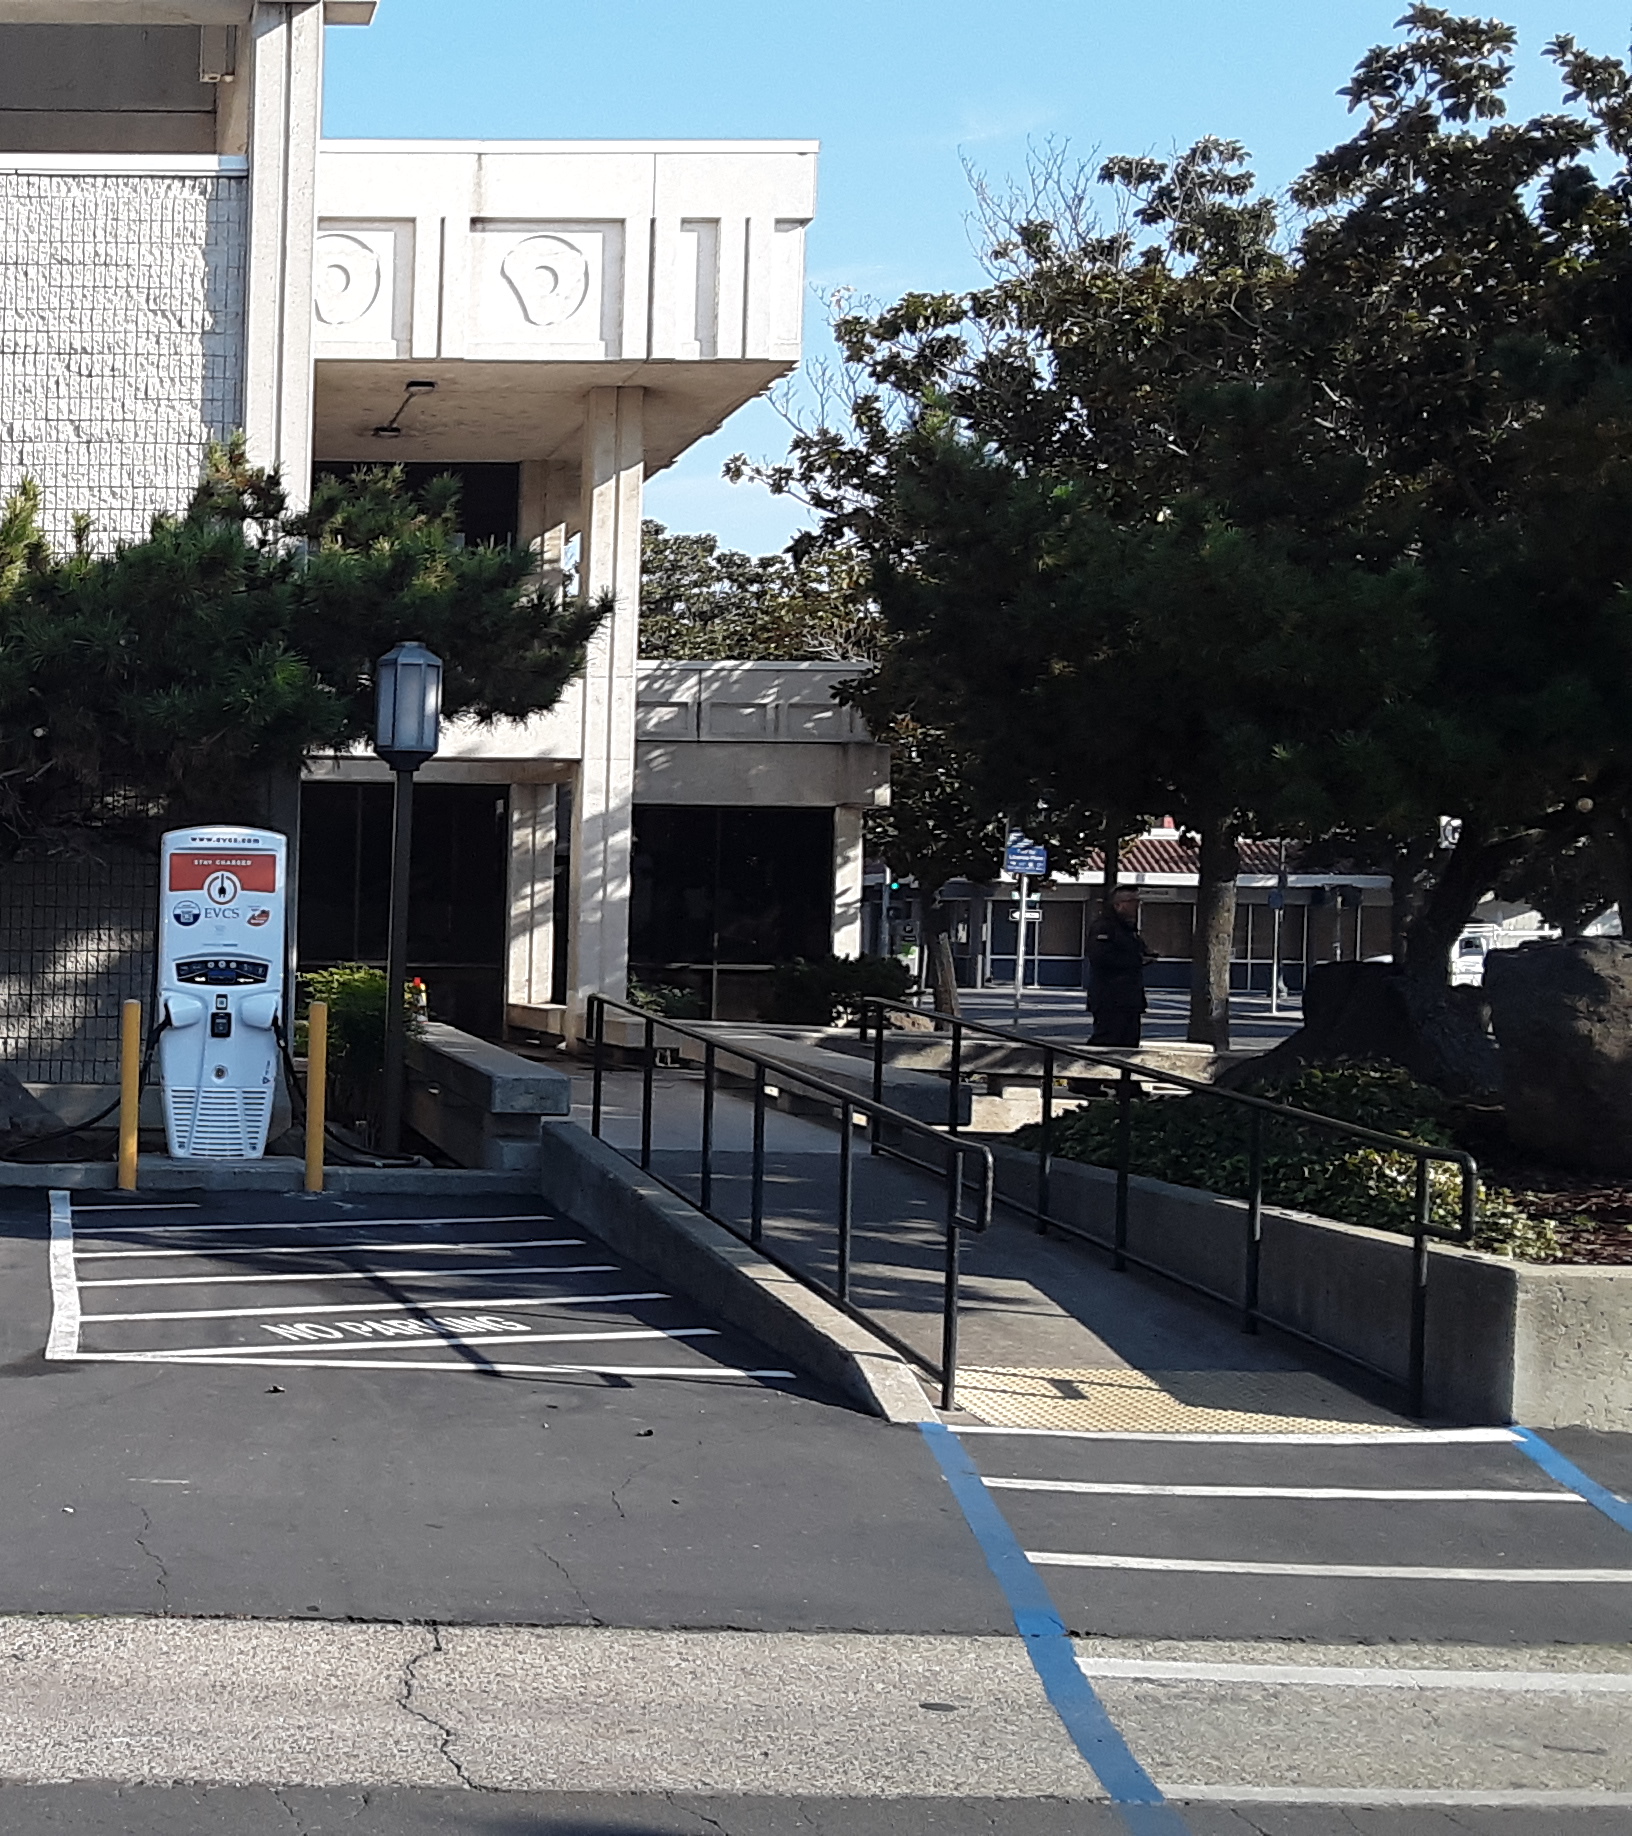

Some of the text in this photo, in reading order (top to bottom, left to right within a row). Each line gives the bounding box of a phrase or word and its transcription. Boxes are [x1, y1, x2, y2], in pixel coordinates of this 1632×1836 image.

[190, 836, 260, 844] www.evcs.com
[204, 907, 240, 919] EVCS
[260, 1315, 532, 1341] NO PARKING
